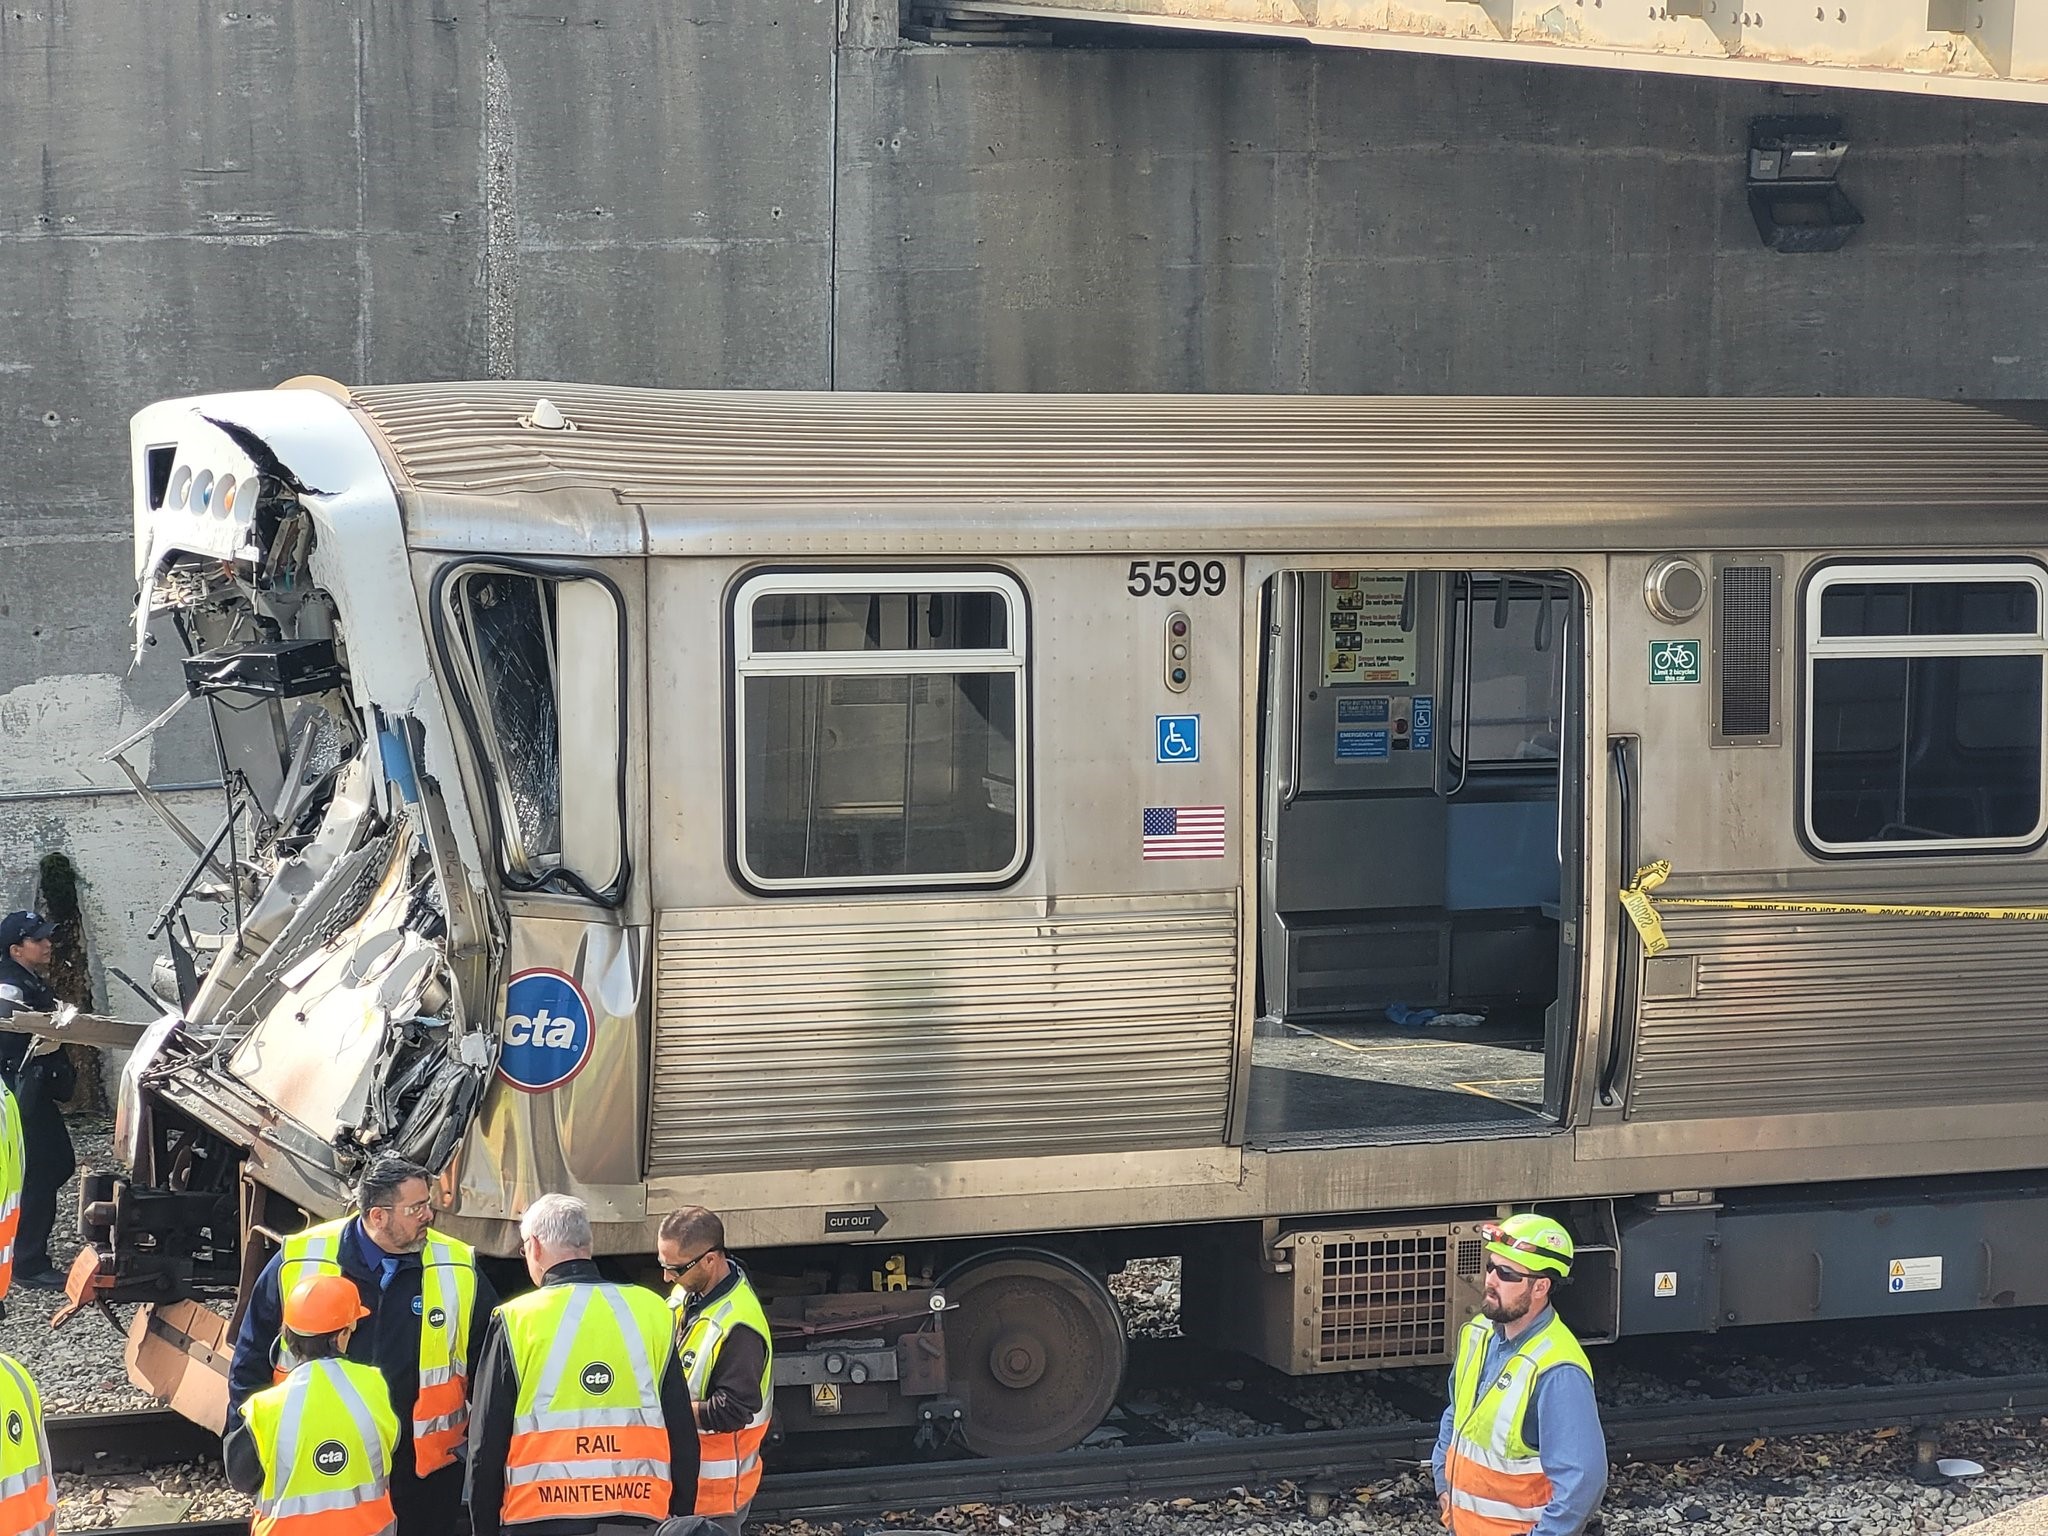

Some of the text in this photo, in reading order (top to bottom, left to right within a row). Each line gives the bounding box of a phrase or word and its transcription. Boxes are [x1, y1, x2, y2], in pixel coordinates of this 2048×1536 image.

[1127, 560, 1226, 597] 5599
[503, 1009, 576, 1050] cta
[829, 1216, 871, 1227] CUT OUT
[430, 1313, 444, 1323] cta
[586, 1372, 609, 1385] cta
[576, 1434, 622, 1455] RAIL
[319, 1450, 344, 1464] cta
[537, 1481, 652, 1503] MAINTENANCE
